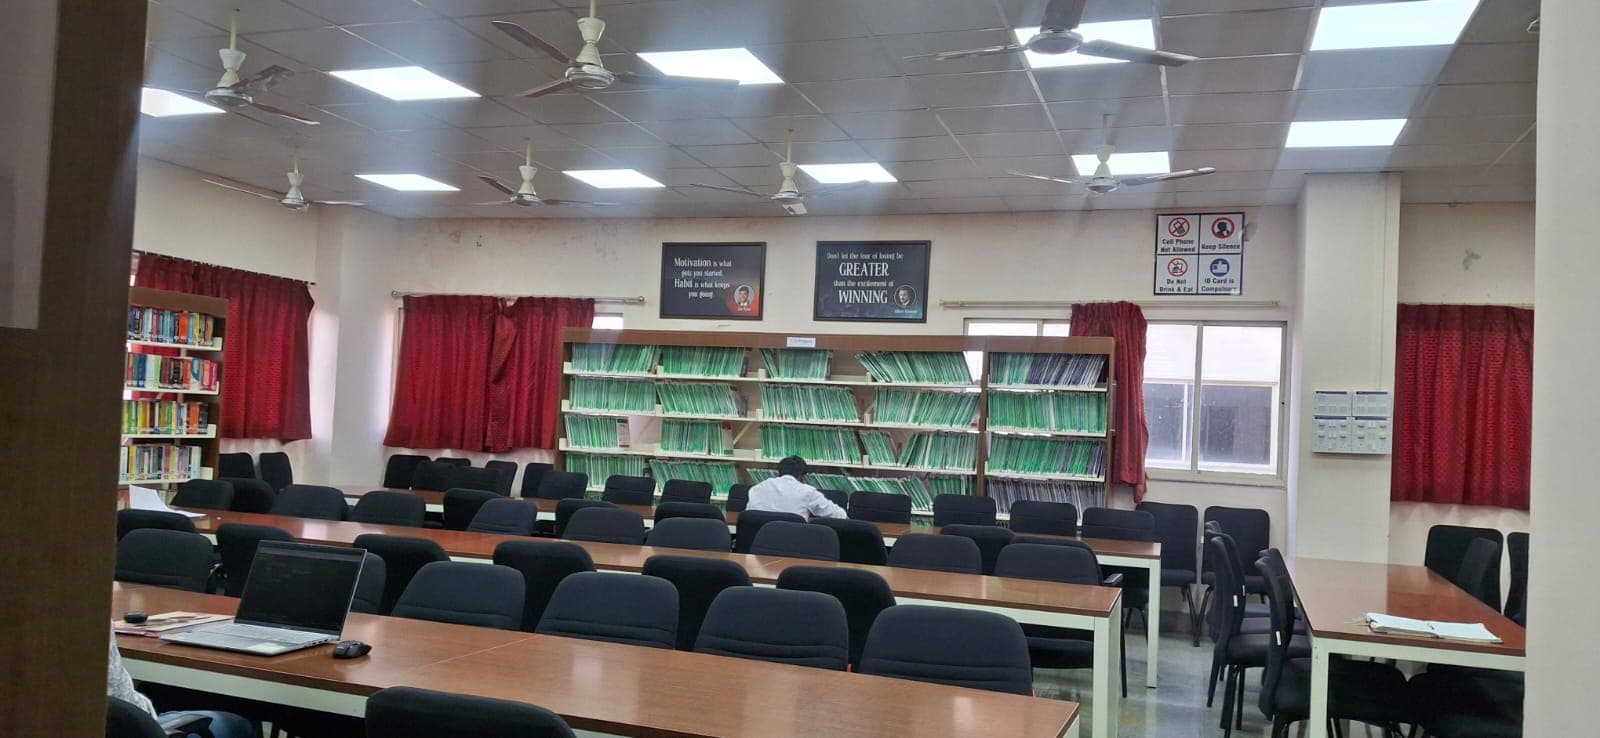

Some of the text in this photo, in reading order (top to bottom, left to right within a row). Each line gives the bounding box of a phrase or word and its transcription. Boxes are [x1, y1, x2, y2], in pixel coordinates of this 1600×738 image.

[674, 257, 712, 267] Motivation
[839, 262, 890, 276] GREATER
[674, 278, 692, 288] Habit
[839, 290, 888, 304] WINNING
